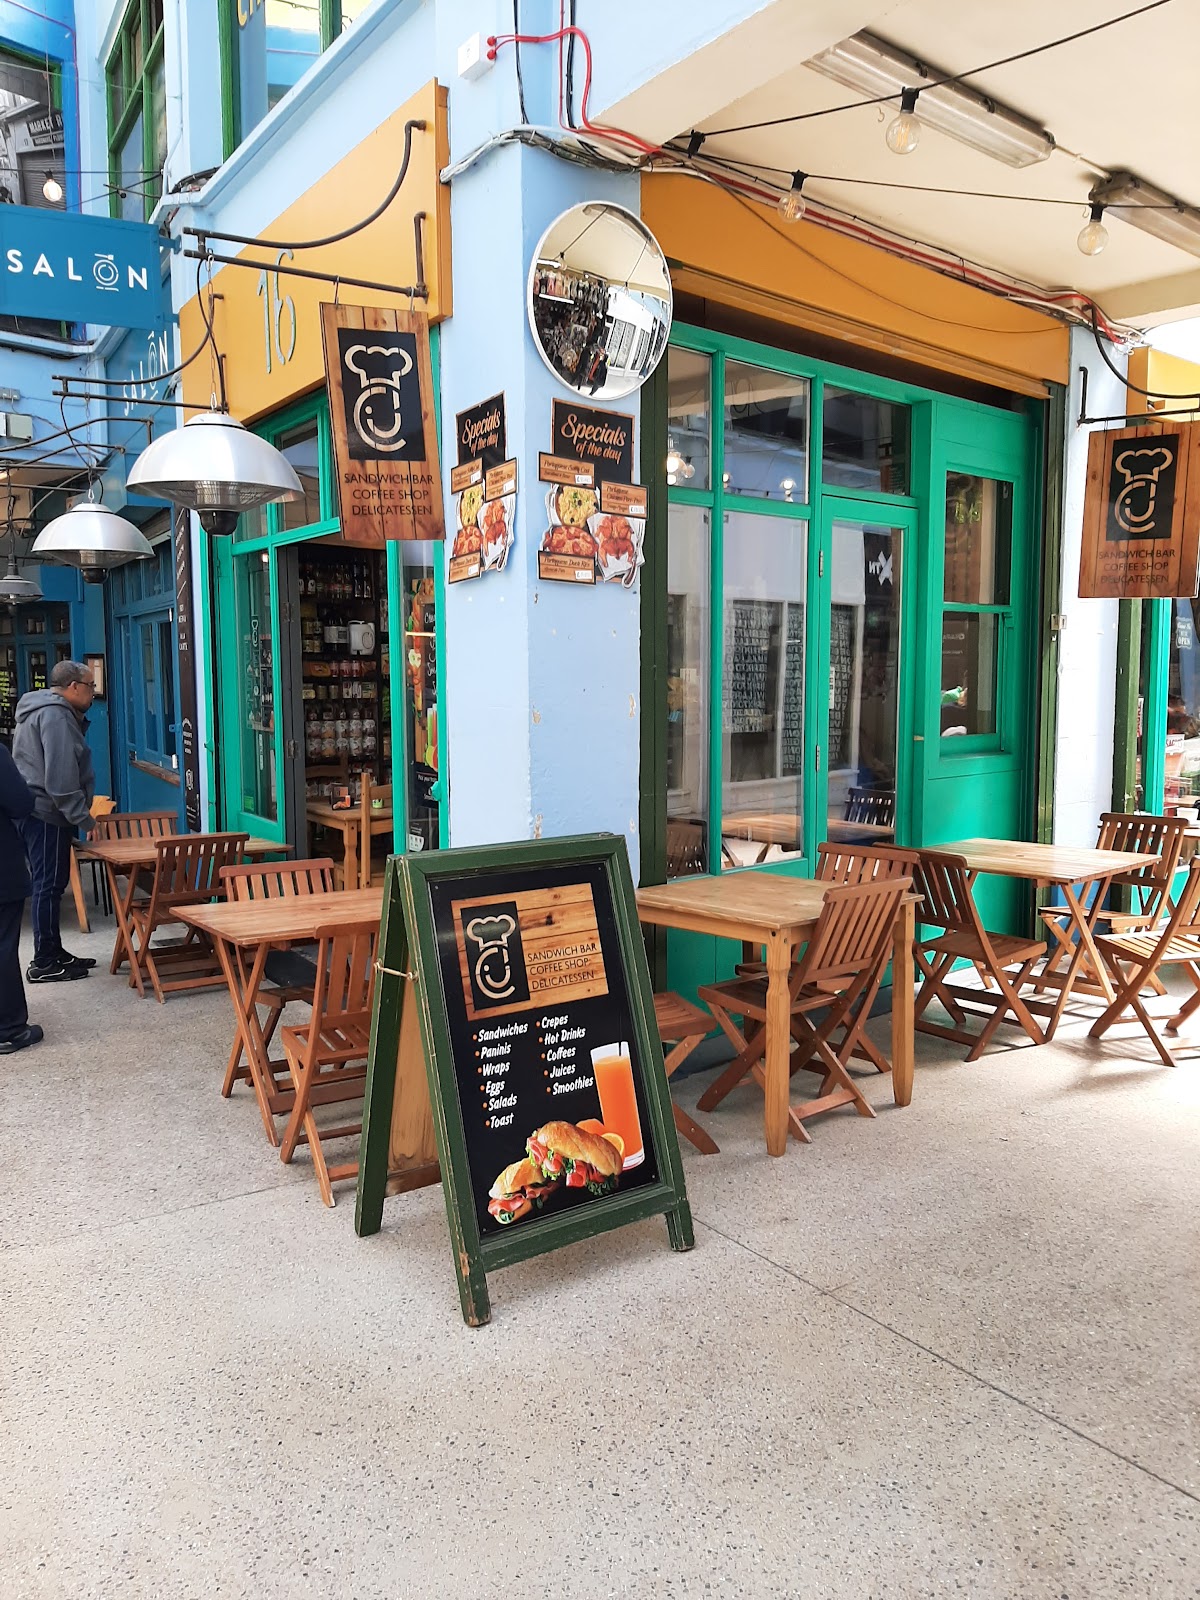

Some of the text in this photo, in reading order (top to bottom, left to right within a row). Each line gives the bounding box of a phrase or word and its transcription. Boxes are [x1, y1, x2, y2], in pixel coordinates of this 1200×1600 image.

[29, 116, 53, 133] MARKET
[257, 249, 296, 374] 16
[461, 408, 501, 448] Specials
[561, 413, 627, 447] Specials
[470, 432, 499, 457] of the day
[575, 440, 622, 465] of the day
[344, 473, 434, 485] SANDWICH BAR
[352, 489, 429, 500] COFFEE SHOP
[352, 504, 432, 516] DELICATESSEN
[1099, 549, 1176, 560] SANDWICH BAR
[1104, 561, 1169, 571] COFFEE SHOP
[1100, 574, 1169, 584] DELICATESSEN
[527, 943, 597, 962] SANDWICH BAR
[530, 957, 589, 976] COFFEE SHOP
[532, 971, 595, 990] DELICATESSEN
[541, 1015, 568, 1029] Crepes
[478, 1022, 528, 1042] Sandwiches
[544, 1027, 586, 1045] Hot Drinks
[480, 1042, 511, 1059] Paninis
[546, 1046, 576, 1061] Coffees
[482, 1062, 510, 1076] Wraps
[549, 1064, 576, 1078] Juices
[485, 1080, 505, 1096] Eggs
[552, 1076, 594, 1095] Smoothies
[488, 1093, 517, 1111] Salads
[490, 1112, 514, 1128] Toast
